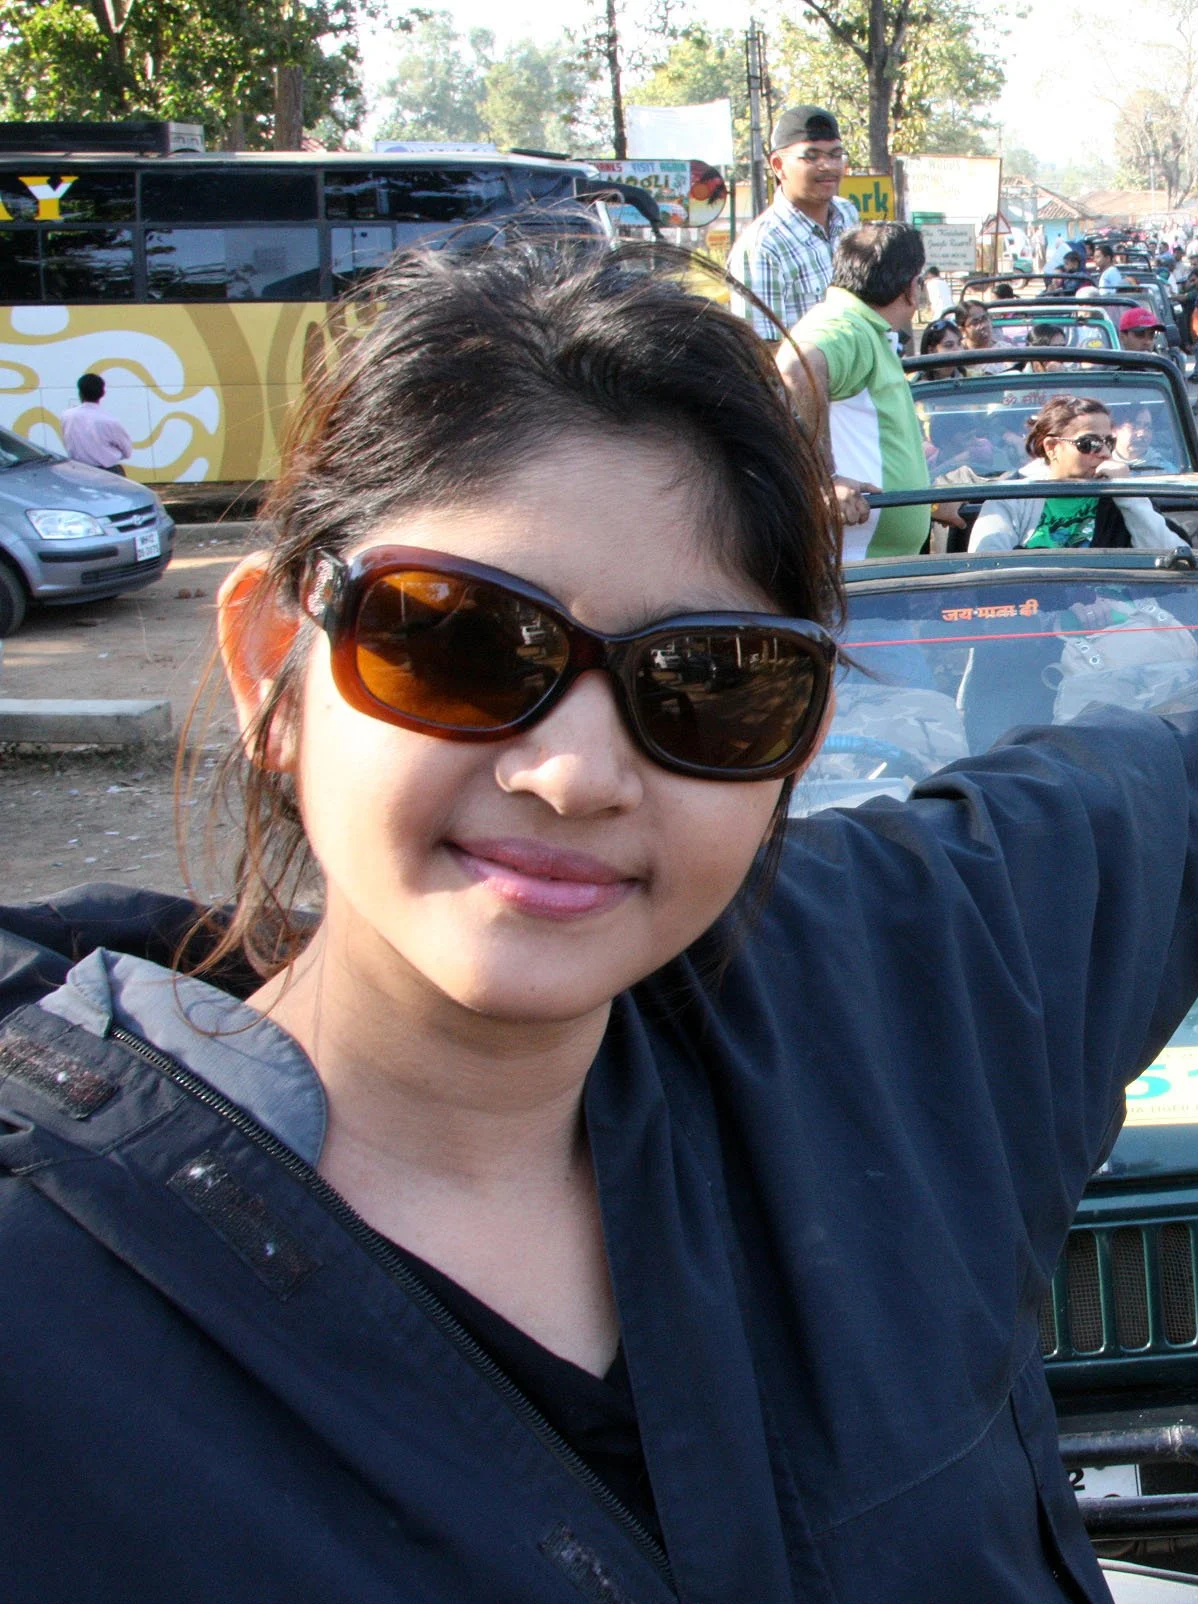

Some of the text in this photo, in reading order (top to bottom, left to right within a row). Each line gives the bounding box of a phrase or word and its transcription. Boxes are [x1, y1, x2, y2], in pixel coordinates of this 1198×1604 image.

[631, 162, 656, 172] VISIT
[942, 608, 973, 622] जय
[1018, 598, 1039, 617] दी
